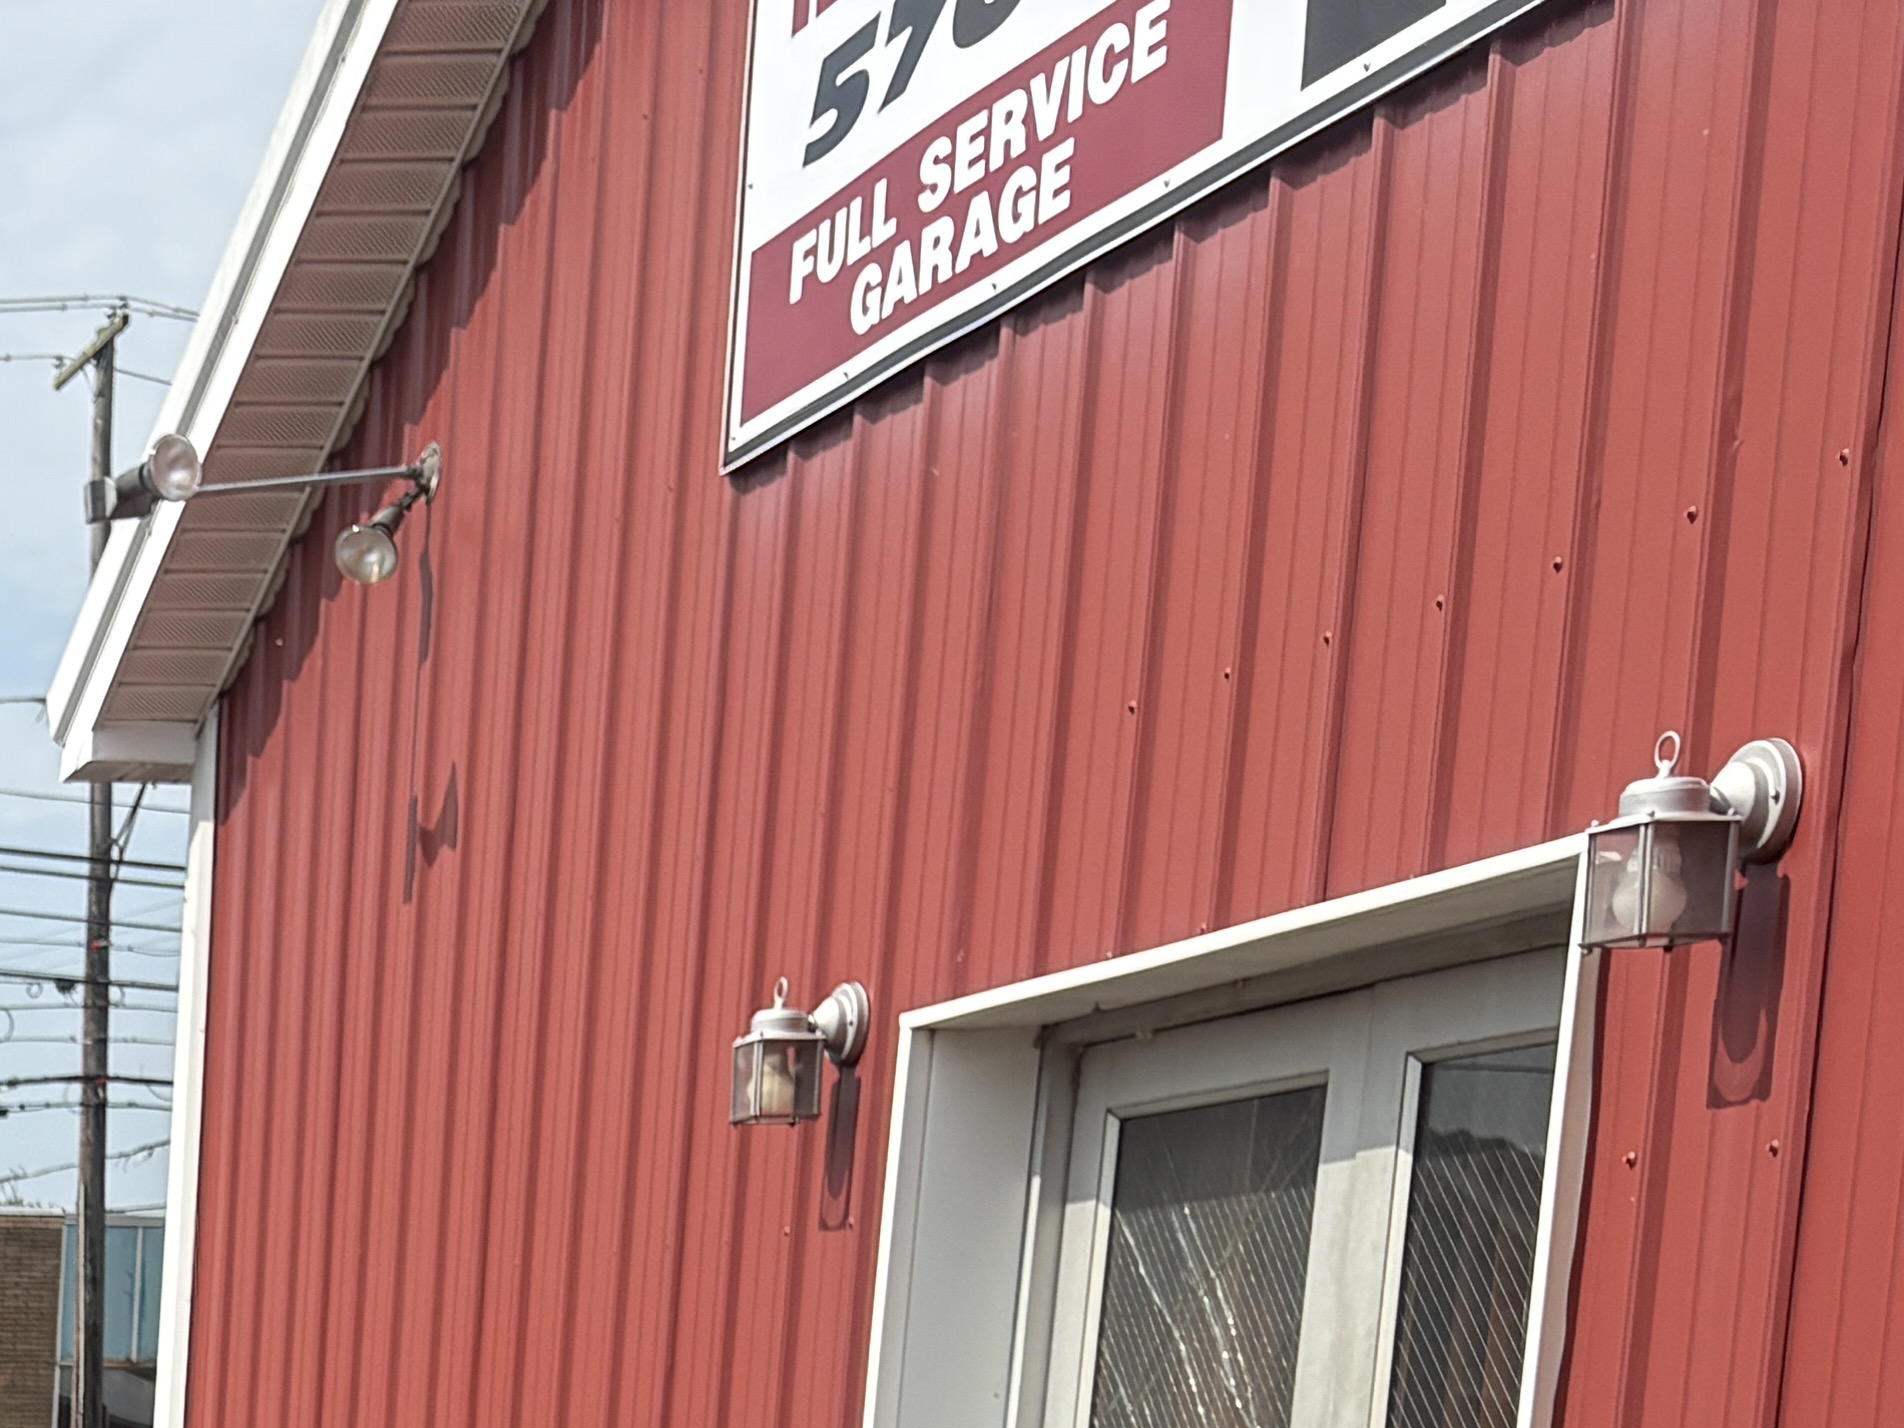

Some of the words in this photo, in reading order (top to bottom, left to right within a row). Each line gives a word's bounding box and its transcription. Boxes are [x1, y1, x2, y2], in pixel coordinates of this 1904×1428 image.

[789, 177, 898, 305] FULL
[918, 0, 1171, 213] SERVICE
[849, 137, 1077, 336] GARAGE
